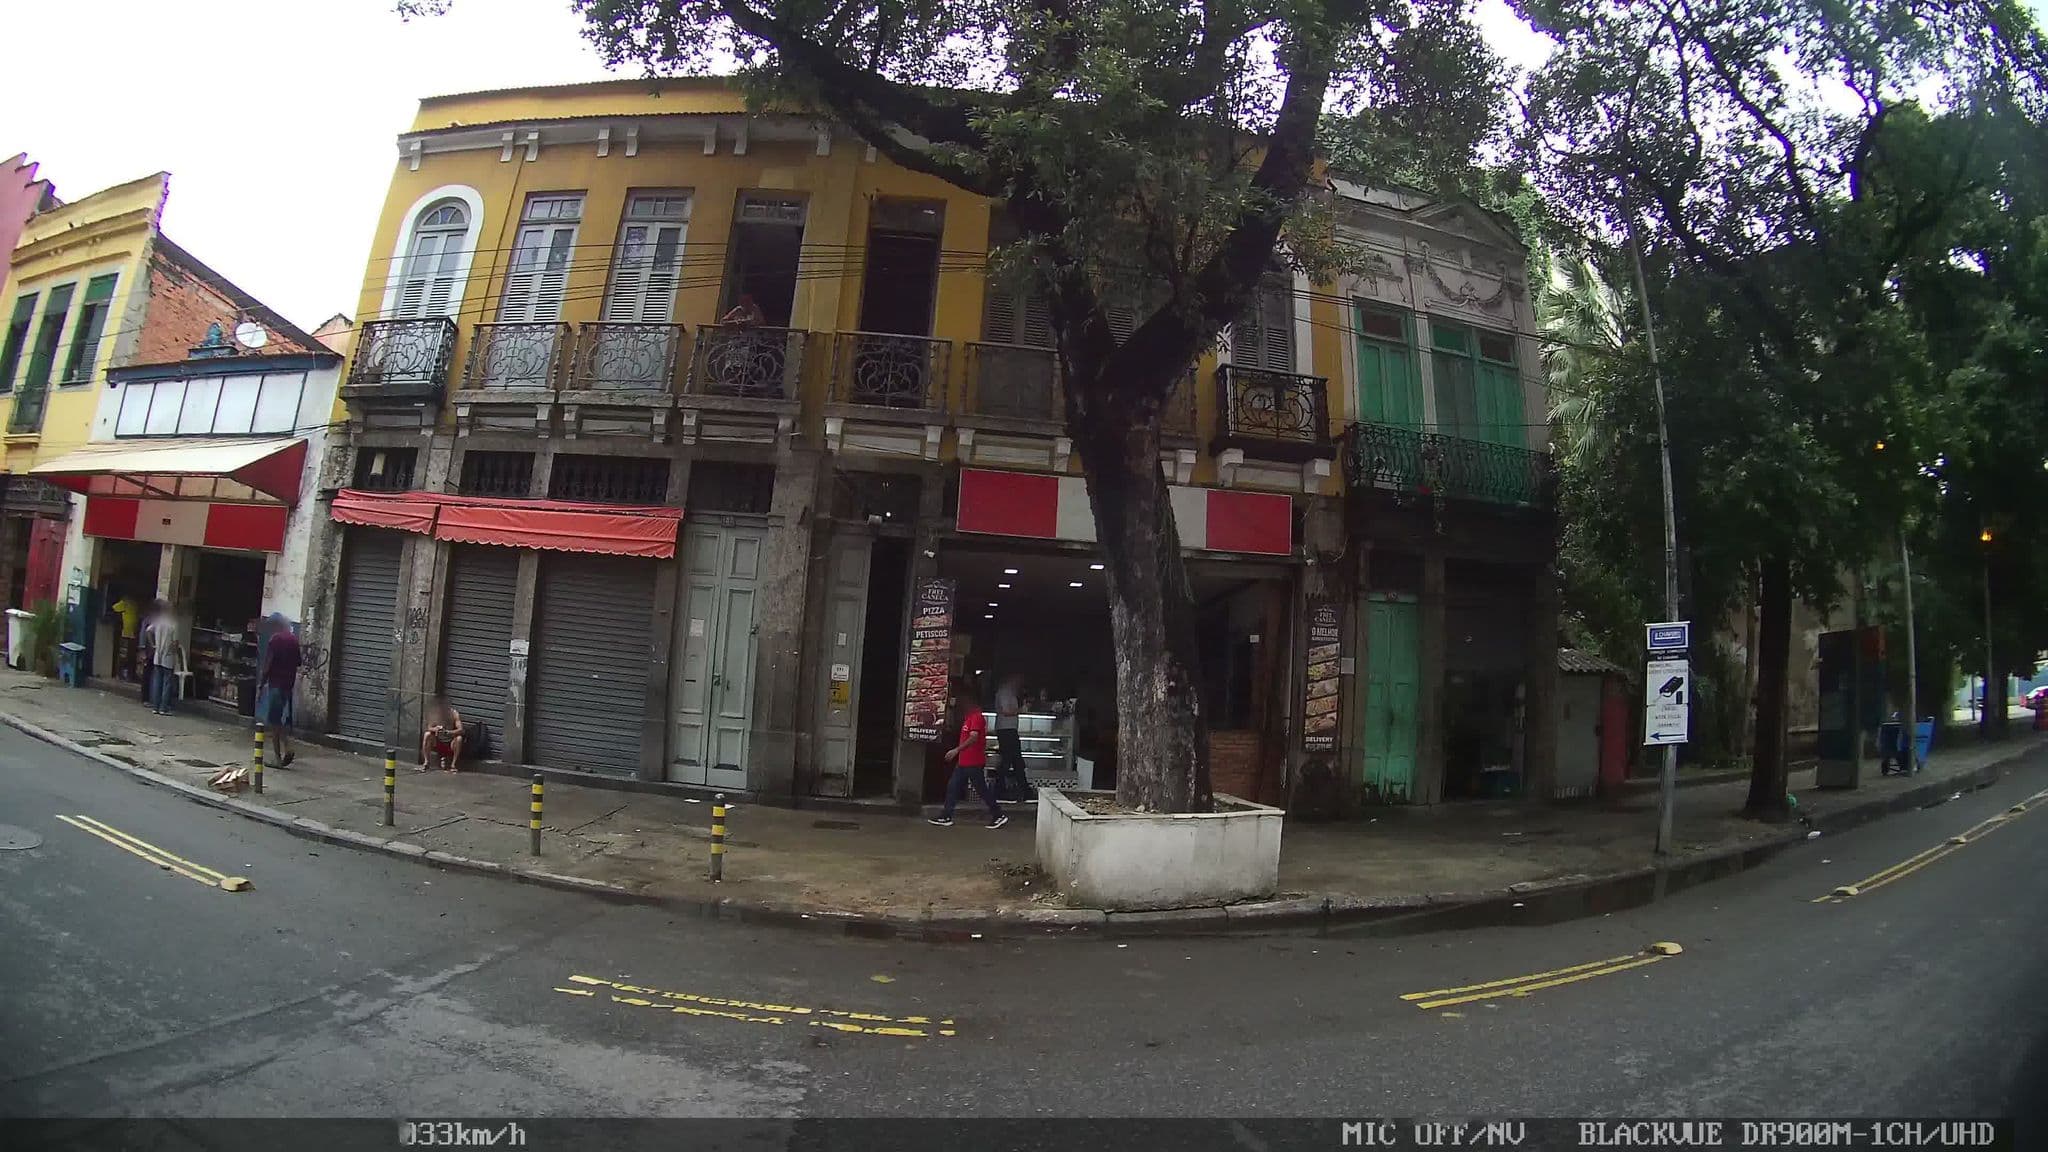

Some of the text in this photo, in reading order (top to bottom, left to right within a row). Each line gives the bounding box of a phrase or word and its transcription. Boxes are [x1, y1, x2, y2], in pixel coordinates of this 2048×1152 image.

[922, 606, 945, 615] PIZZA
[915, 629, 948, 639] PETISCOS
[909, 727, 937, 735] DELIVERY
